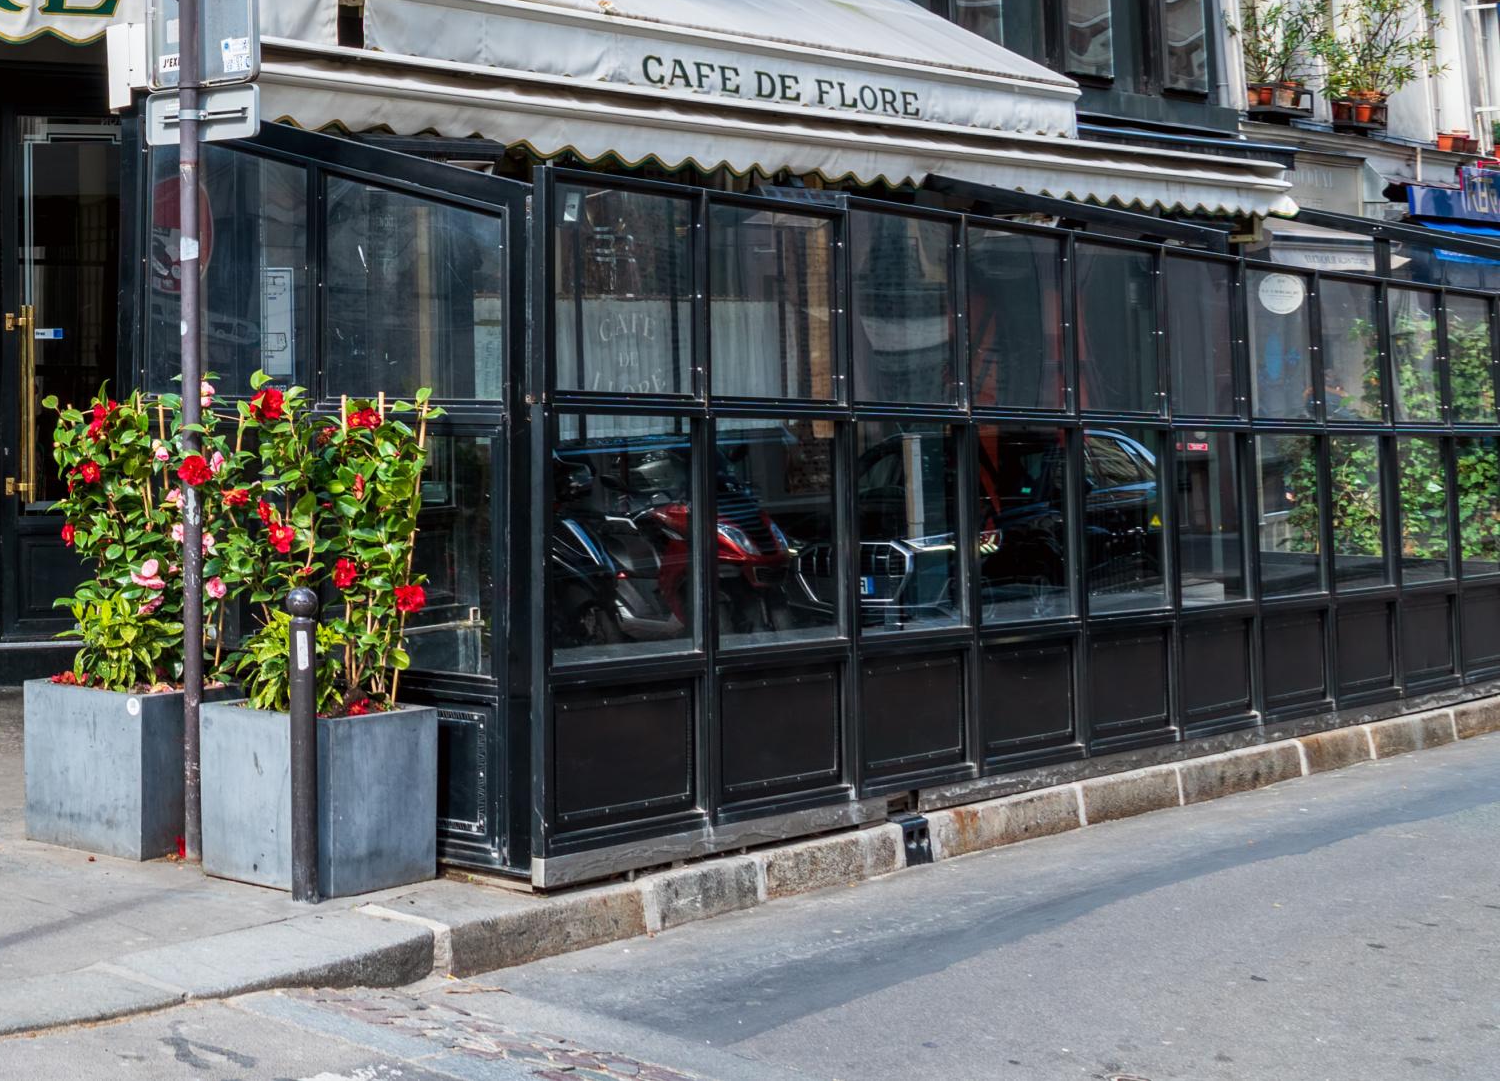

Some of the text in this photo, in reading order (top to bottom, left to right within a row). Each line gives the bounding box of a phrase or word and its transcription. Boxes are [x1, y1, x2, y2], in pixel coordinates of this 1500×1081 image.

[642, 54, 920, 117] CAFE DE FLORE
